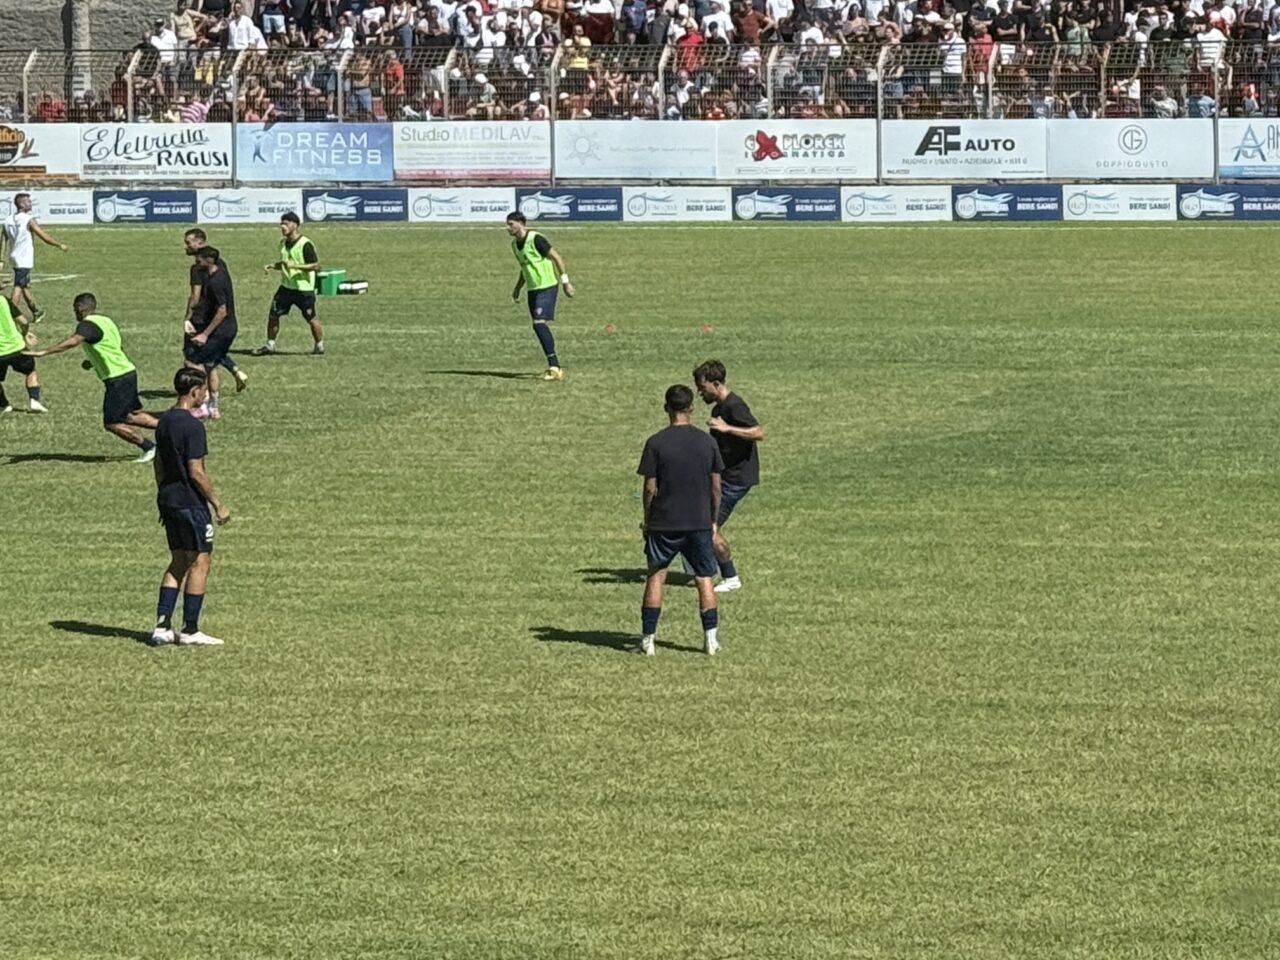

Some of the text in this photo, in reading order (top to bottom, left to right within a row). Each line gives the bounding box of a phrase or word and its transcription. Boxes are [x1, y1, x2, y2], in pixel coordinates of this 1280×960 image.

[277, 131, 368, 148] DREAM
[400, 126, 532, 141] Studio MEDILAV
[964, 138, 1016, 152] AUTO
[157, 150, 229, 167] RAGUSI
[272, 149, 382, 165] FITNESS
